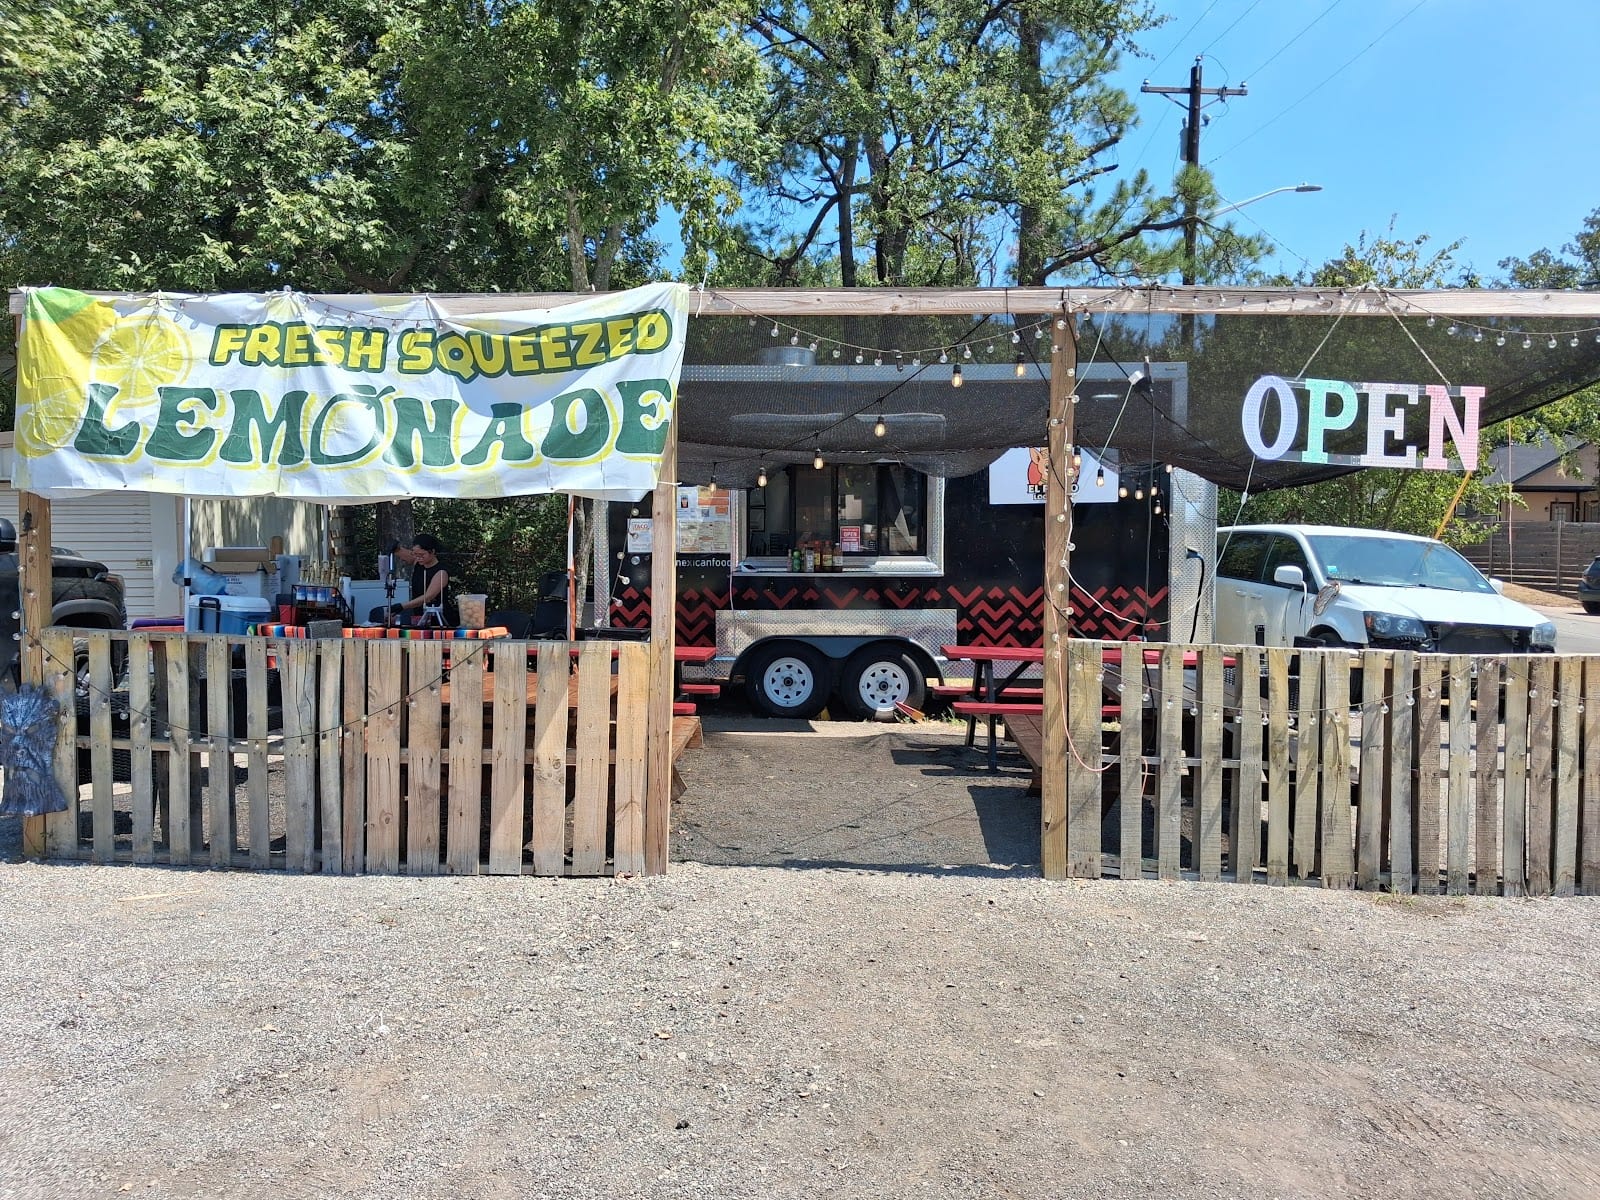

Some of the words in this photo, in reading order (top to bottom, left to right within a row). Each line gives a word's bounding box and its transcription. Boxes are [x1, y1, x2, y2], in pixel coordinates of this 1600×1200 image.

[209, 323, 389, 373] FRESH
[396, 308, 672, 384] SQUEEZED
[73, 378, 673, 468] LEMONADE
[1242, 375, 1486, 471] OPEN
[1028, 484, 1041, 493] EL
